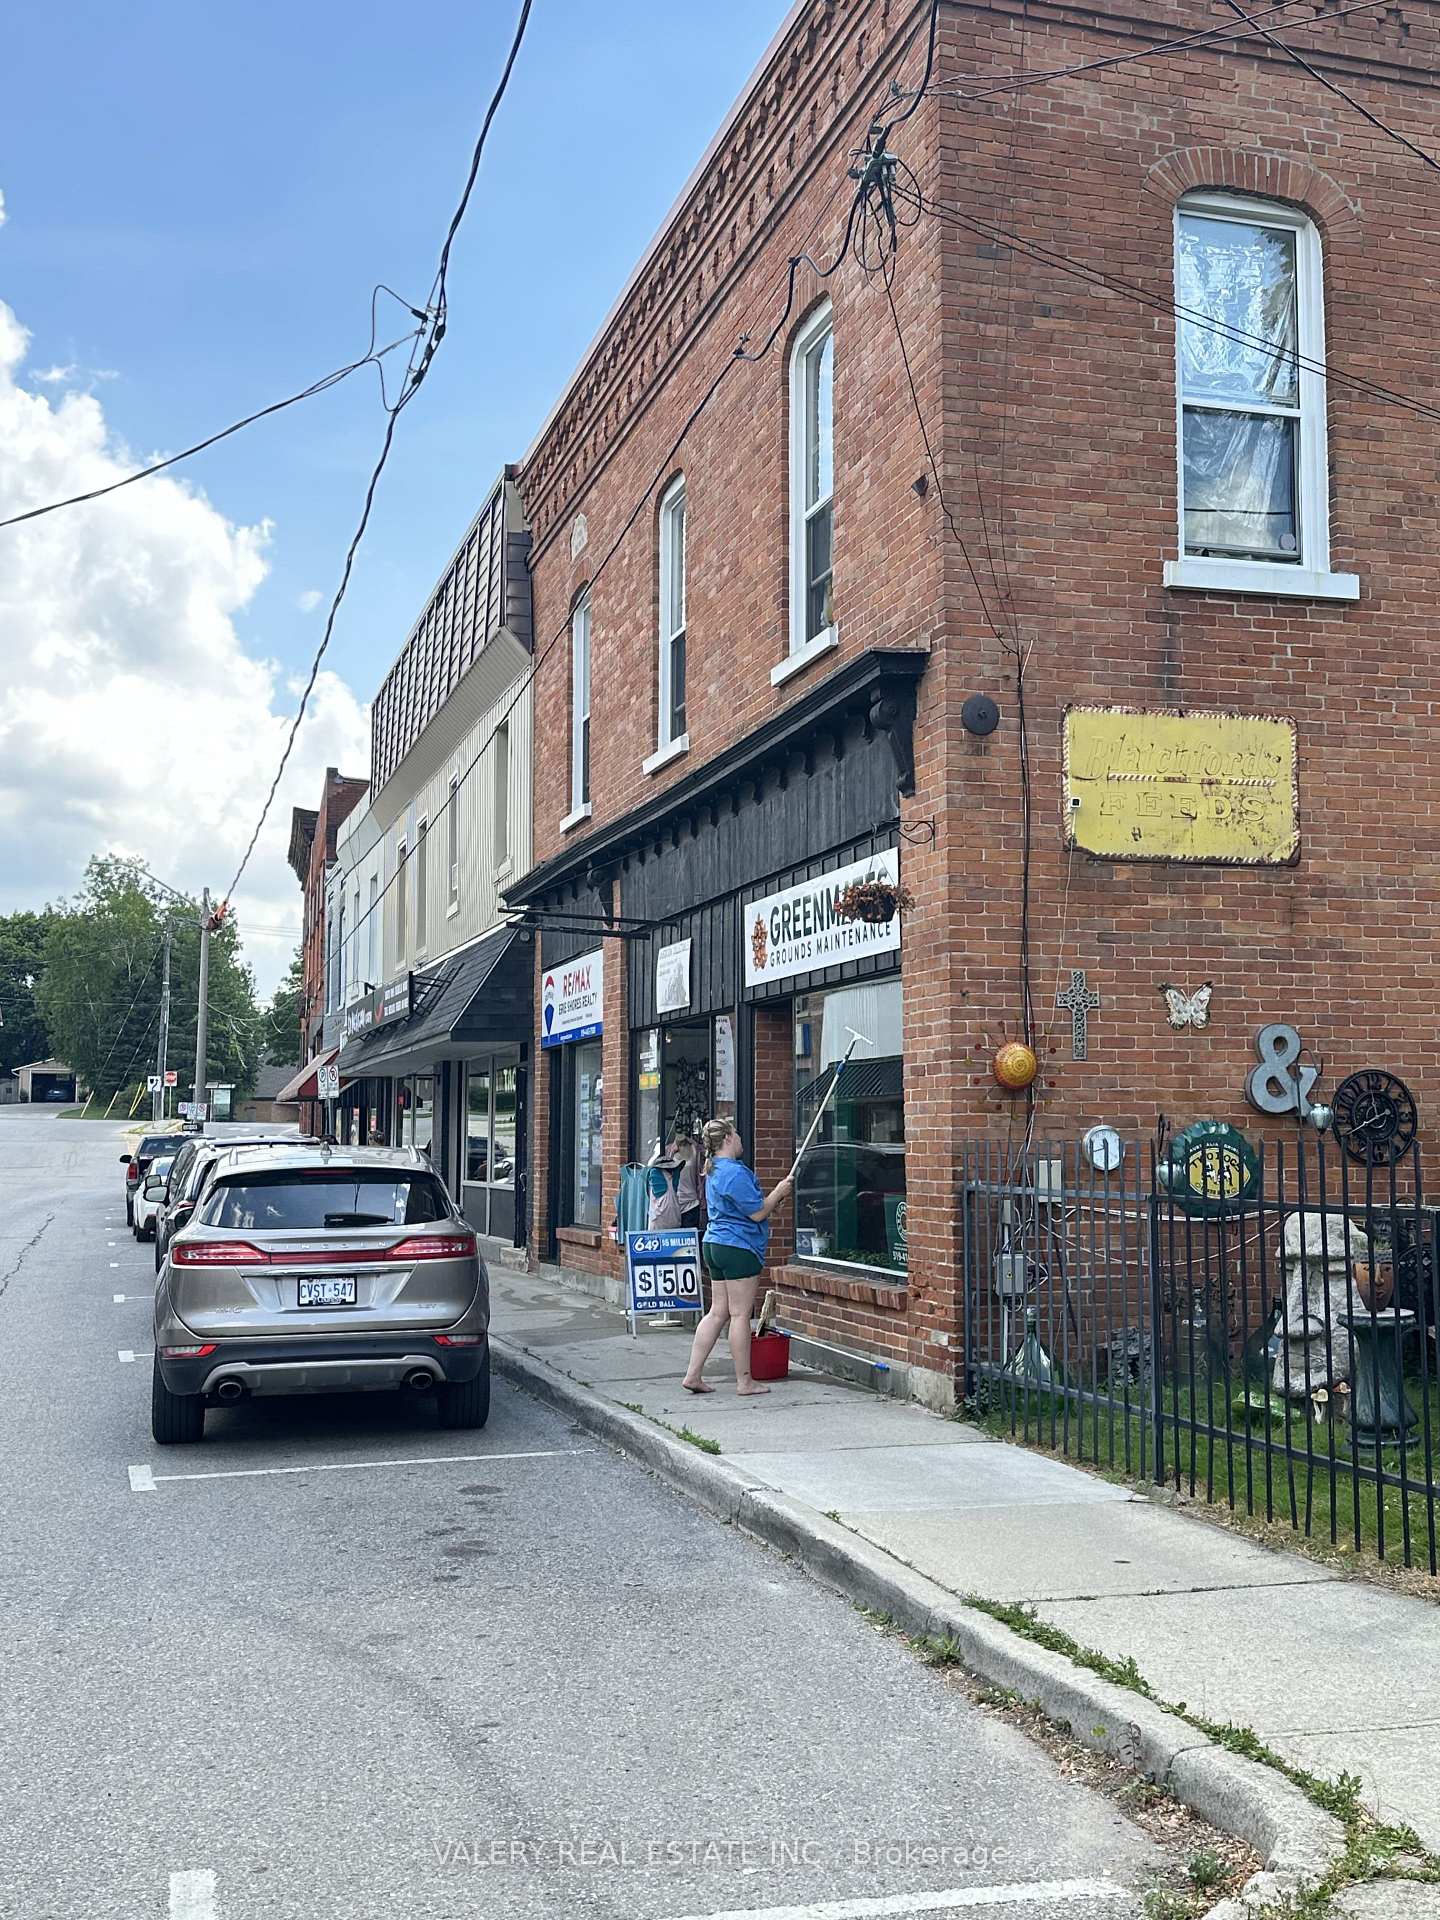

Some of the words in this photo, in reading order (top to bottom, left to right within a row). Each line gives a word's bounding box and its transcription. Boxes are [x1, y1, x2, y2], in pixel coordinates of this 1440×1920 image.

[1099, 791, 1266, 822] FEEDS
[769, 867, 889, 947] GREENM
[769, 941, 812, 967] GROUNDS
[816, 922, 891, 955] MAINTENANCE
[563, 965, 592, 997] RE/MAX
[582, 992, 598, 1008] REALTY
[1190, 1152, 1214, 1168] TO
[268, 1241, 387, 1250] LINCOLN
[634, 1237, 660, 1252] 649
[669, 1237, 697, 1248] MILLION
[300, 1283, 327, 1299] CVST
[333, 1282, 353, 1297] 547
[659, 1300, 676, 1308] BALL
